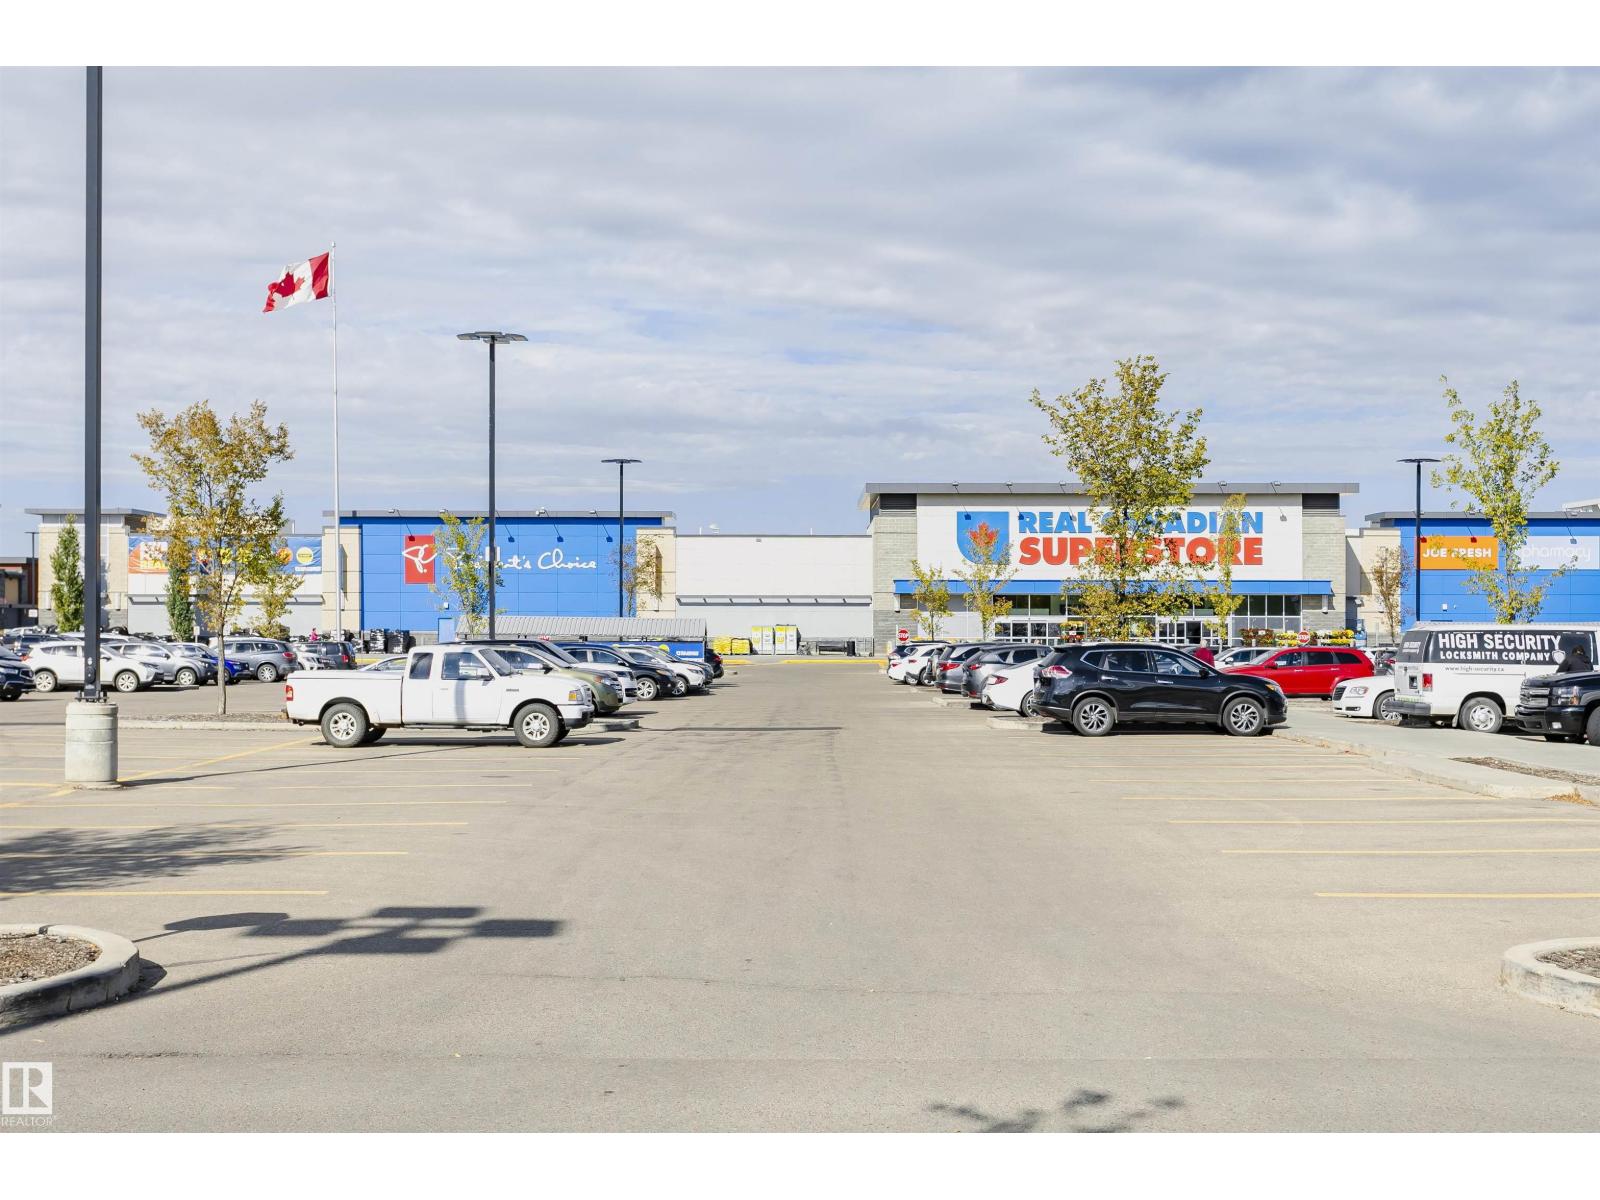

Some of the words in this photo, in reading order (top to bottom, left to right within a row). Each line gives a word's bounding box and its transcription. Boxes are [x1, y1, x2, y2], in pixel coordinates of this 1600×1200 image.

[1018, 511, 1092, 534] REAL
[538, 548, 597, 570] Choice
[1422, 547, 1448, 558] JOE
[1438, 633, 1479, 649] HIGH
[1483, 633, 1562, 650] SECURITY
[1440, 651, 1499, 660] LOCKSMITH
[1502, 651, 1551, 661] COMPANY
